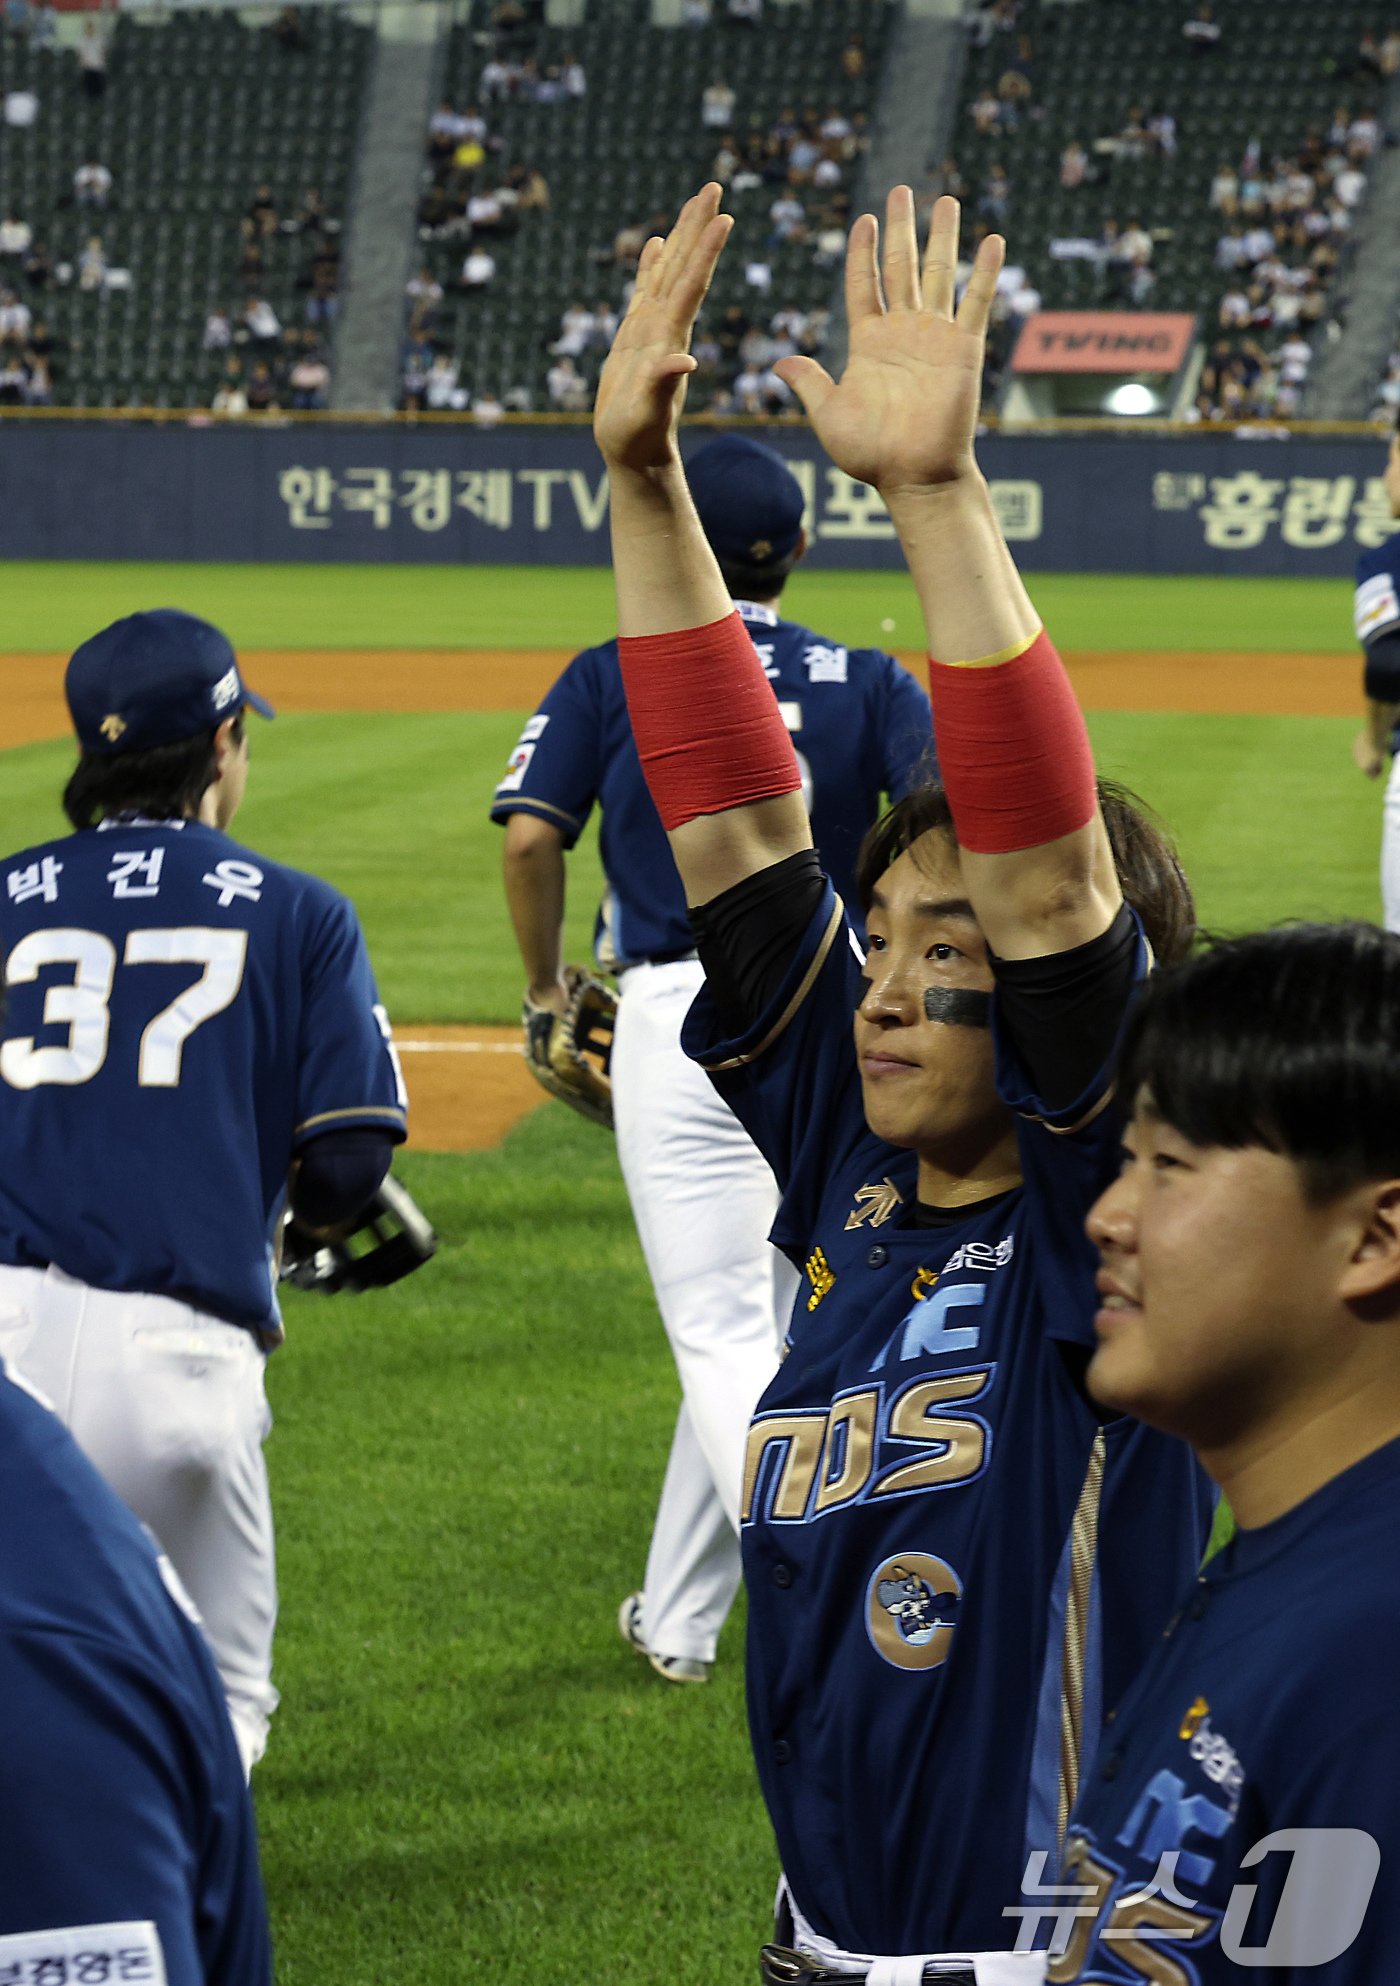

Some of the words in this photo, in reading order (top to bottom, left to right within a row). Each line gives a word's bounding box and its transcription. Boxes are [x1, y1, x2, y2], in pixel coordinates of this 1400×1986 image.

[1040, 331, 1172, 350] TVING
[279, 465, 612, 532] 한국경제TV
[0, 927, 249, 1091] 37
